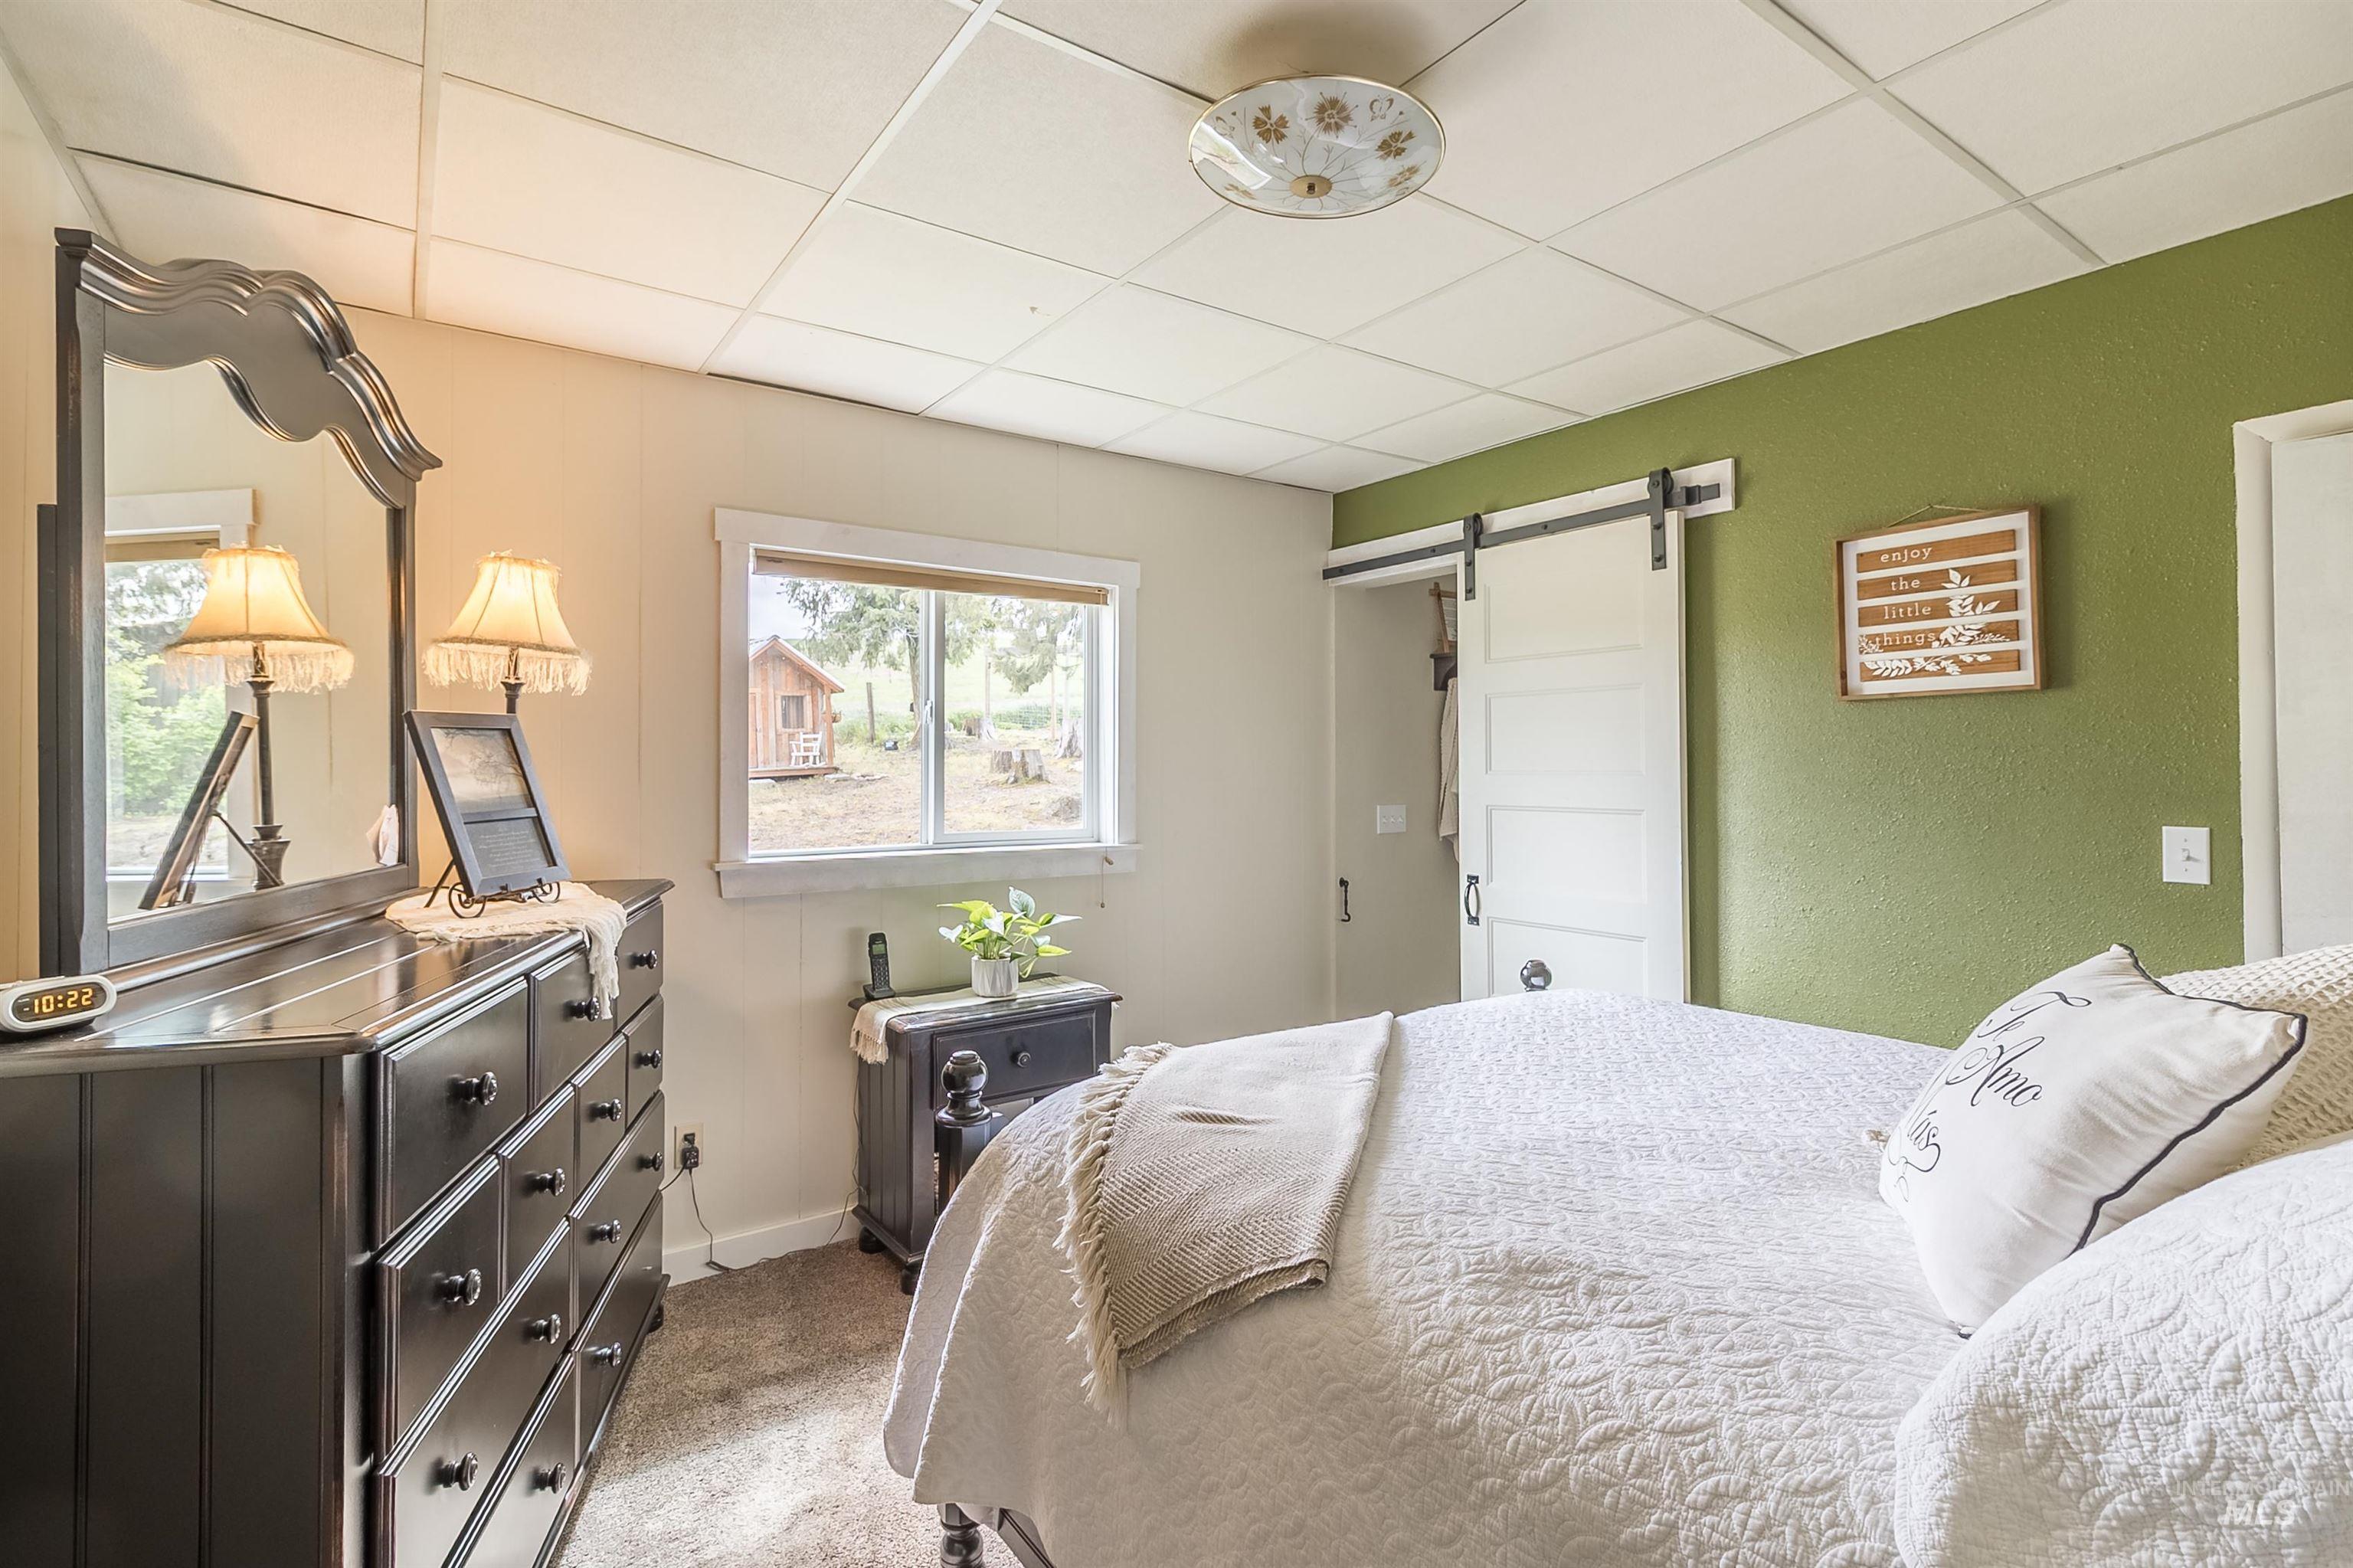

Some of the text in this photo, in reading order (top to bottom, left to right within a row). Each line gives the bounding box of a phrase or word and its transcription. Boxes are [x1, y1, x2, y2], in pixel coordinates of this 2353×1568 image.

[1880, 546, 1932, 563] enjoy
[1890, 576, 1921, 591] the
[1883, 601, 1932, 620] little
[1875, 632, 1936, 646] things
[33, 987, 93, 1014] 10:22
[1945, 1036, 2045, 1107] Amo
